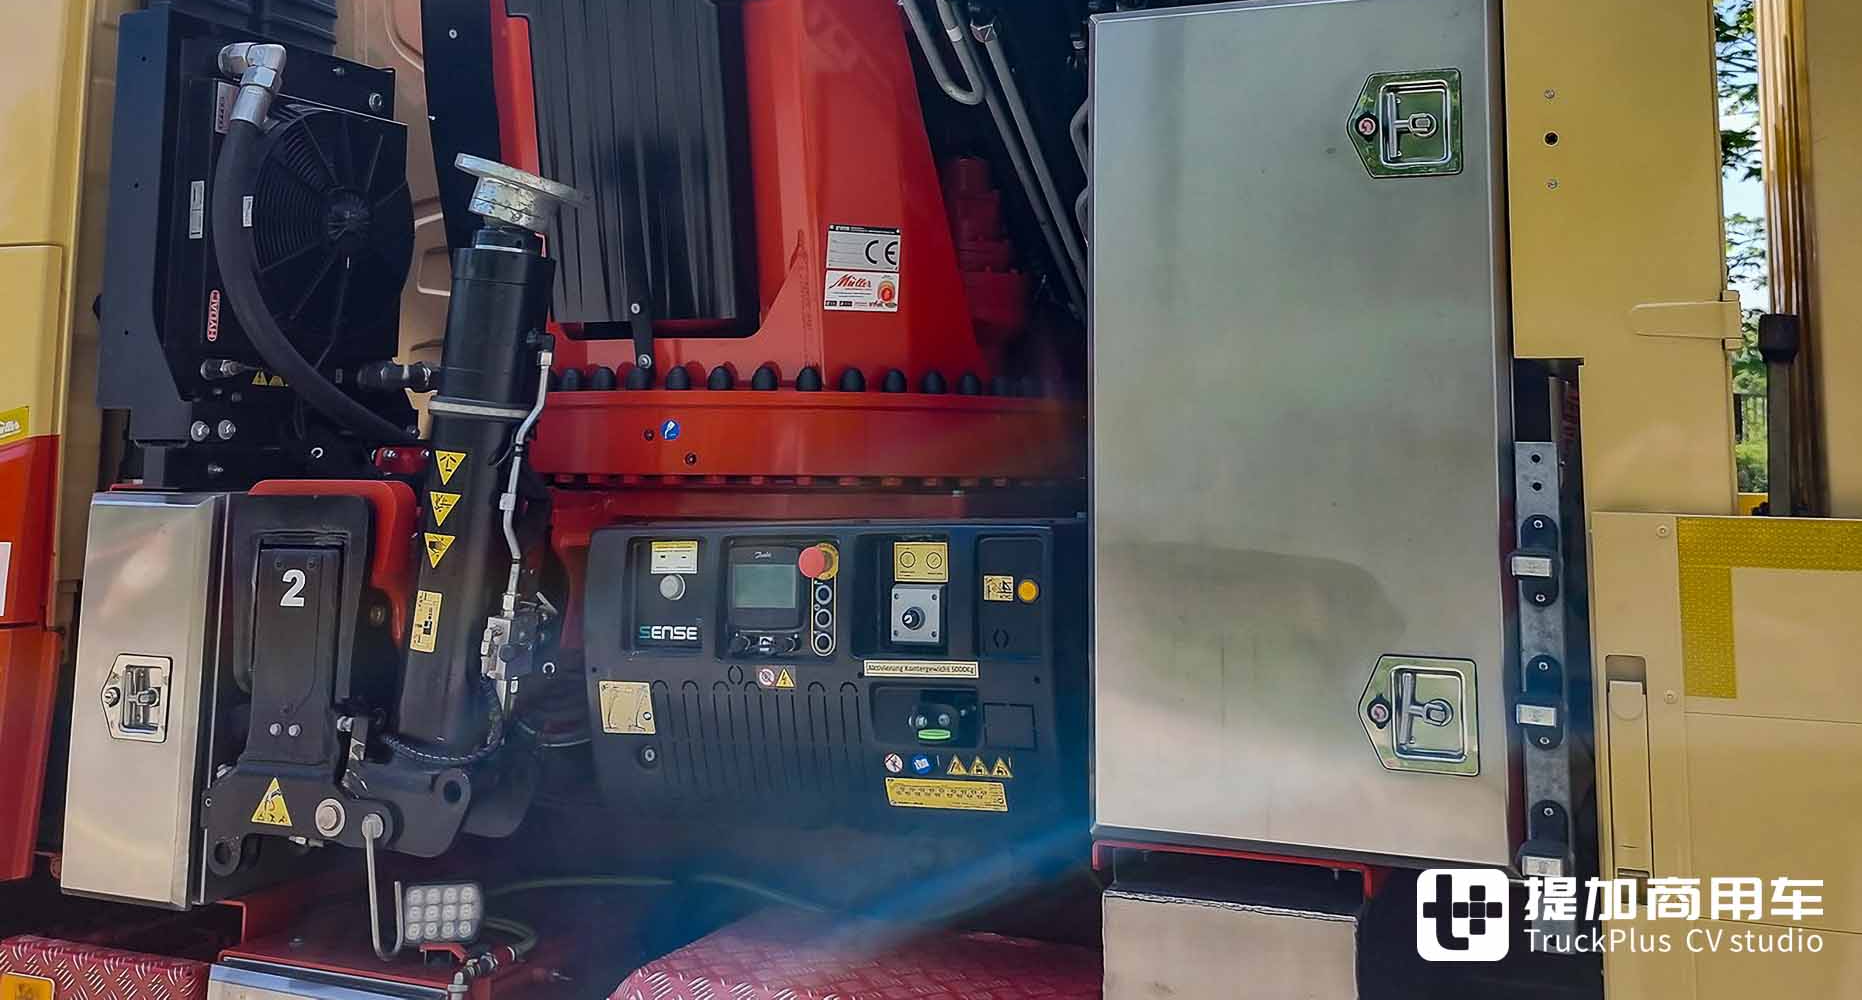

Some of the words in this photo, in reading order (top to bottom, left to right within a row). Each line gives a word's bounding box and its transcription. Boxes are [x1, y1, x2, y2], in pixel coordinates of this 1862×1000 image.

[829, 273, 872, 289] Müller
[280, 569, 305, 607] 2
[640, 625, 698, 640] SENSE
